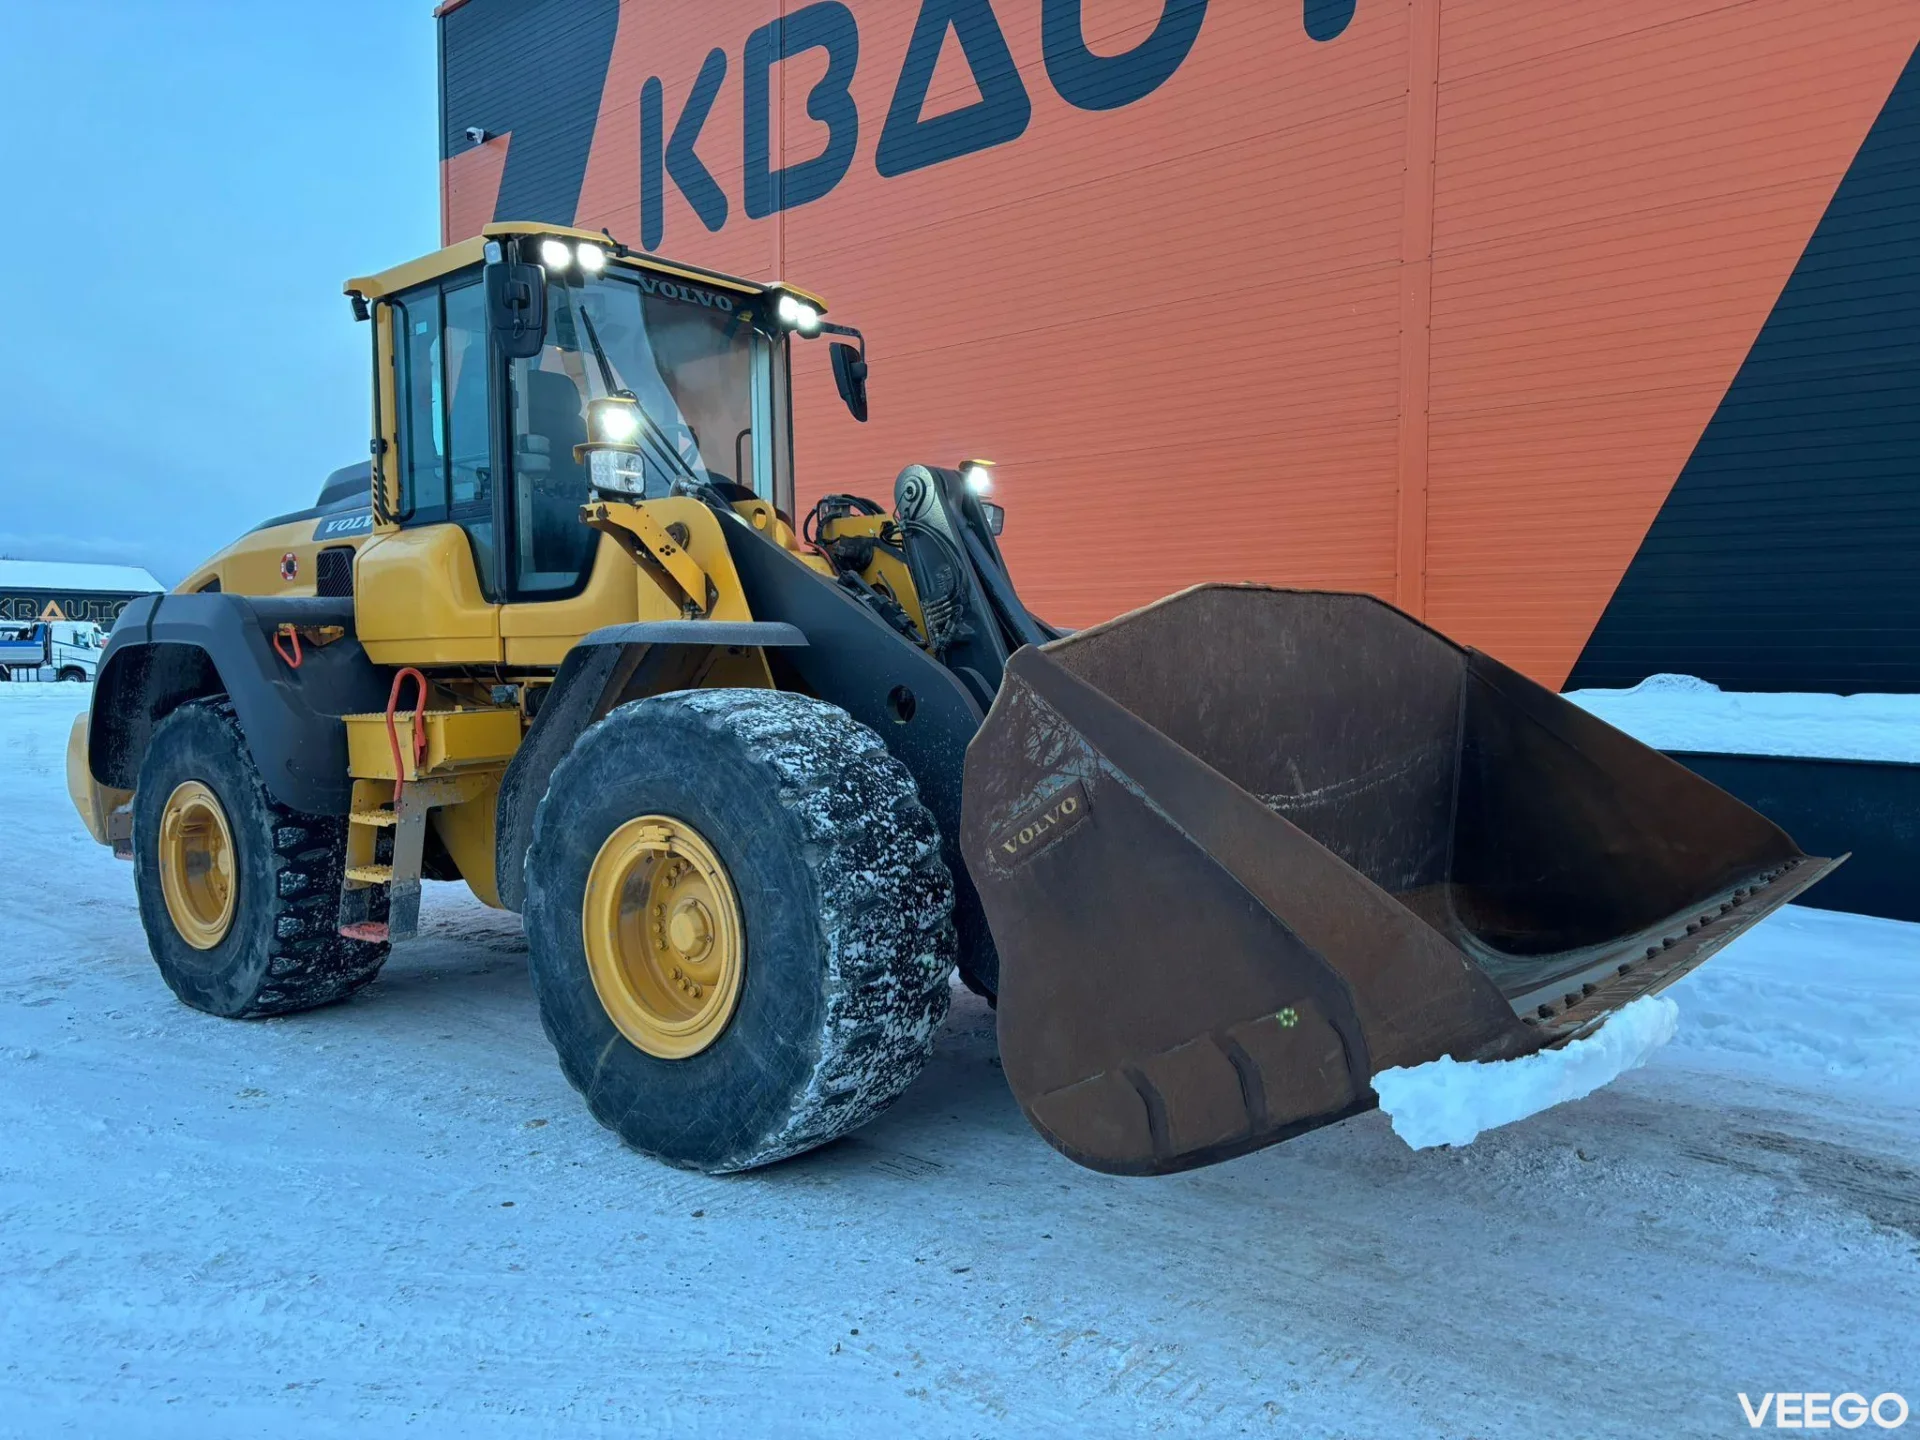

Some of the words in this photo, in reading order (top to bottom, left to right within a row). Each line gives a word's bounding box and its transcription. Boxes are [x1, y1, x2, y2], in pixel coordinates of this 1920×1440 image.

[640, 0, 1355, 252] KBAU
[638, 277, 733, 312] VOLVO
[325, 514, 373, 533] VOLV
[1002, 797, 1077, 853] VOLVO
